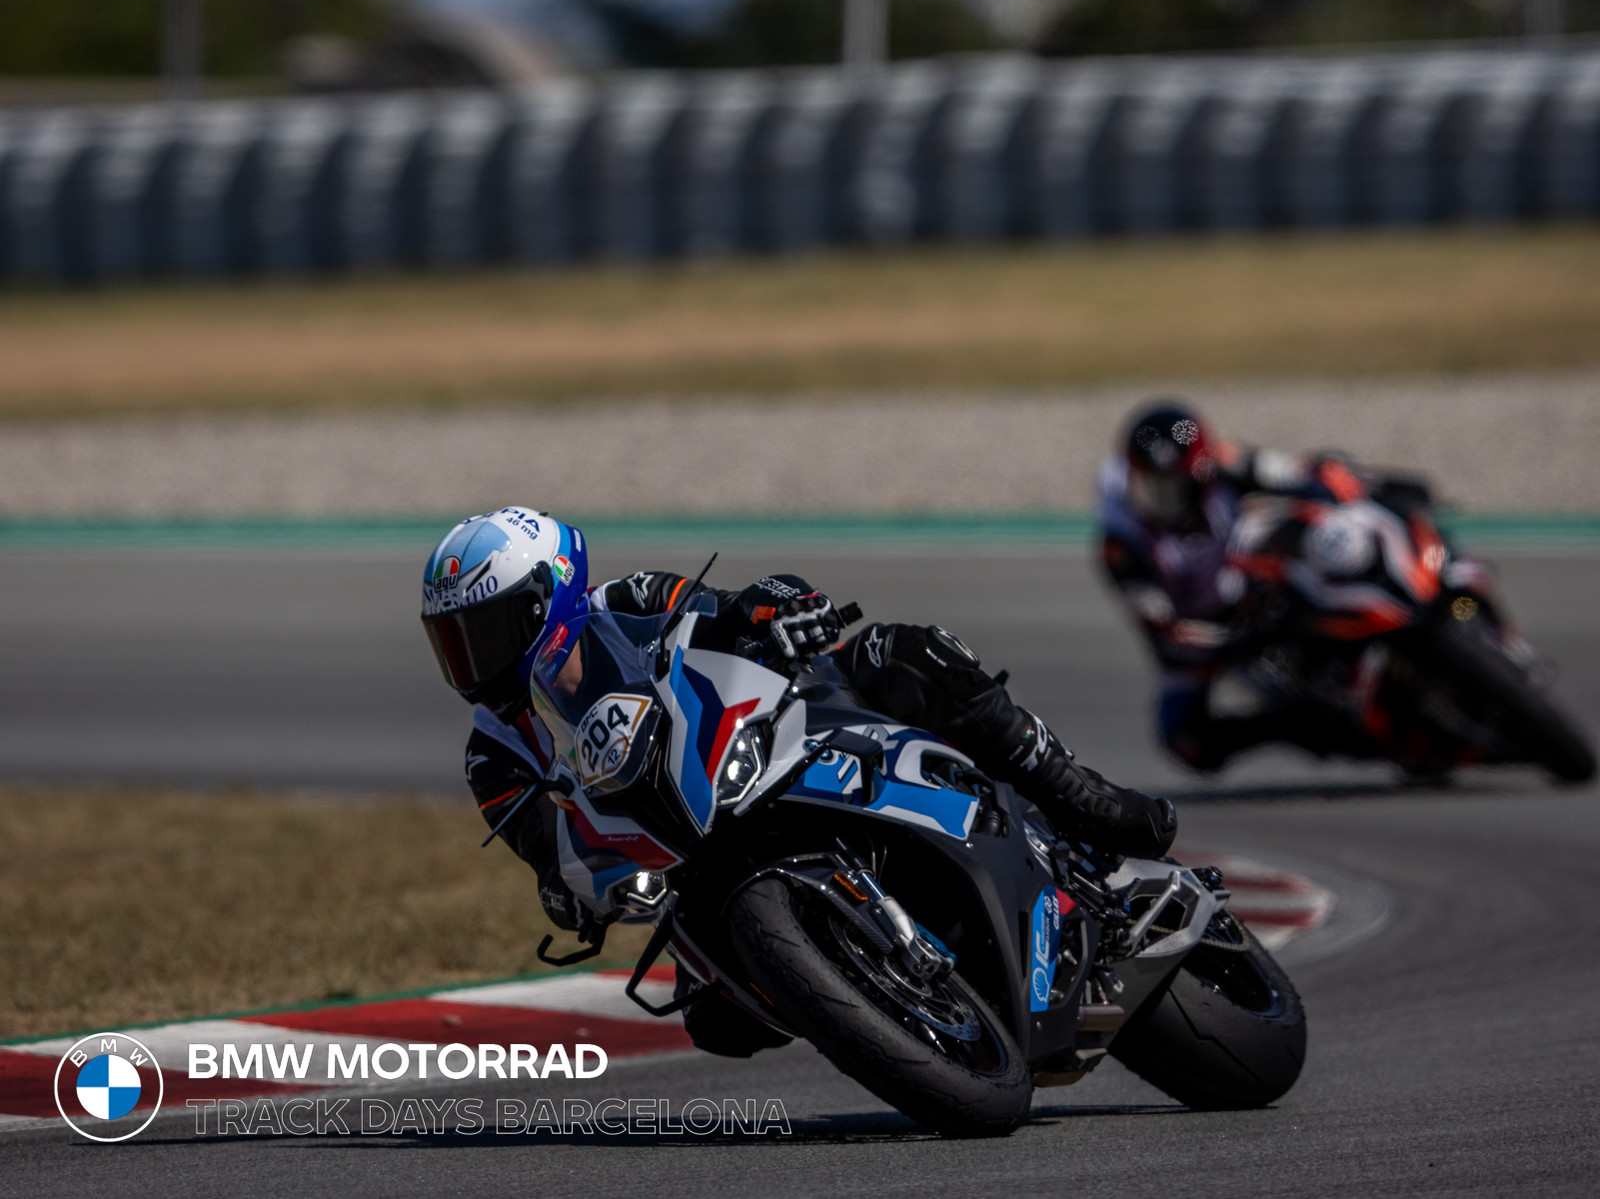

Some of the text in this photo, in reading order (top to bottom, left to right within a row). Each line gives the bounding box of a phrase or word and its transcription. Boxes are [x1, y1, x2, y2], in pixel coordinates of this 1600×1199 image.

[506, 516, 539, 541] 46 mg
[436, 575, 457, 593] agv
[581, 702, 630, 773] 204
[607, 748, 622, 765] 12
